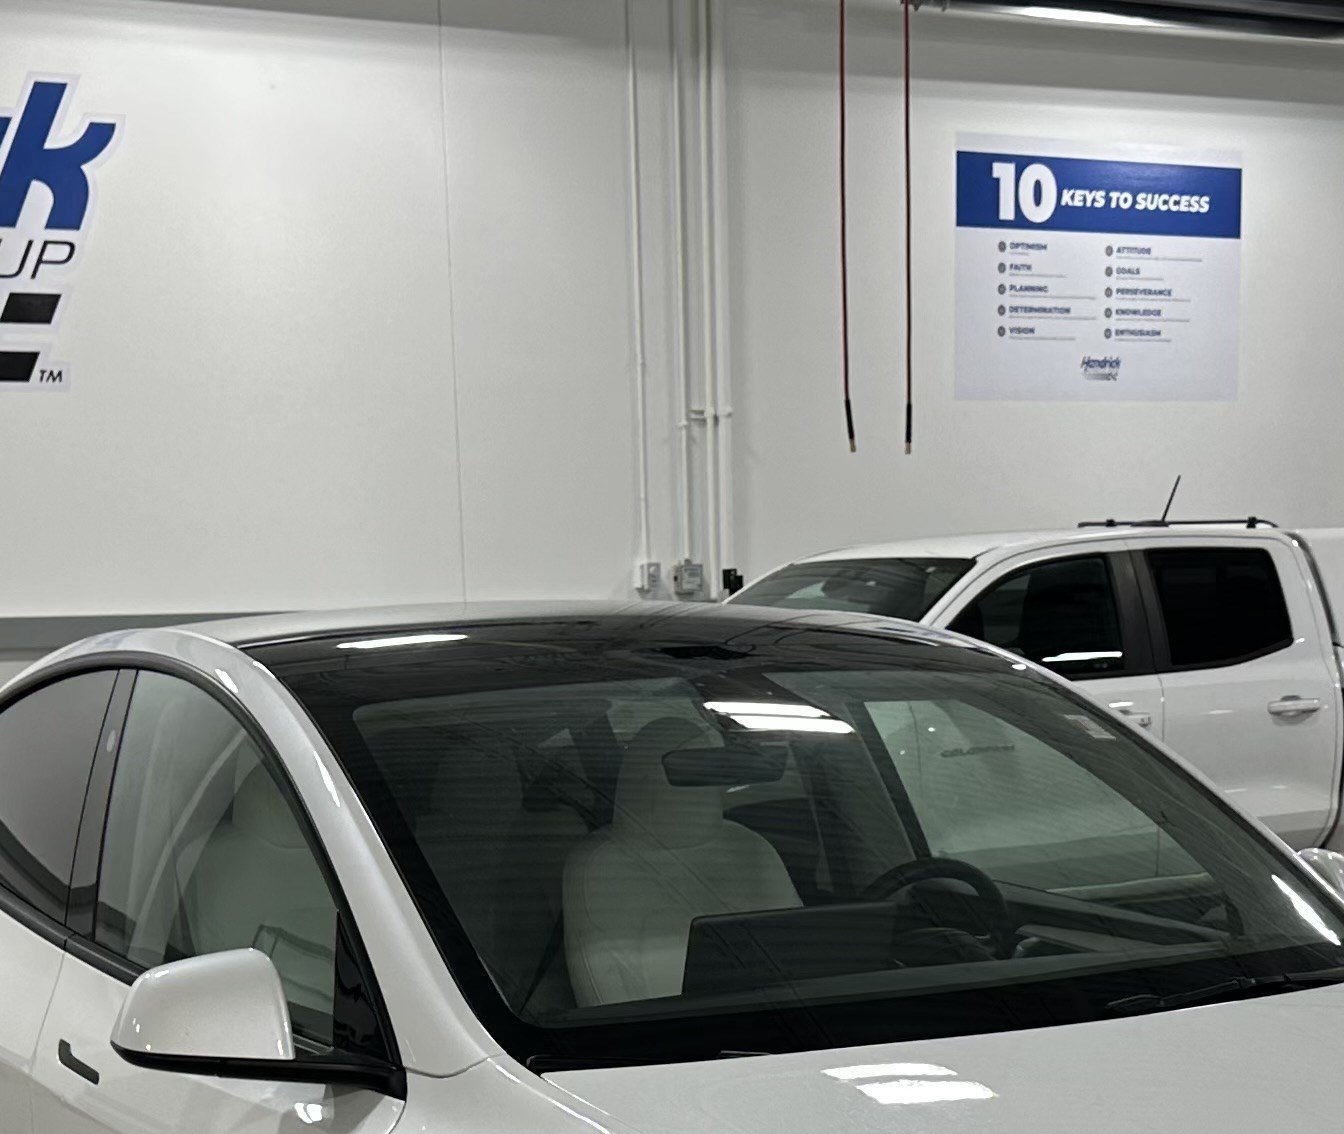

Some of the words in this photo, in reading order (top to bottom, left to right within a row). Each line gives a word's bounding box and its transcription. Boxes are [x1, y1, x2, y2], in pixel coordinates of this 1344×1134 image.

[991, 161, 1058, 224] 10
[1060, 188, 1106, 208] KEYS
[1109, 191, 1133, 210] TO
[1135, 193, 1210, 214] SUCCESS
[39, 369, 63, 383] TM
